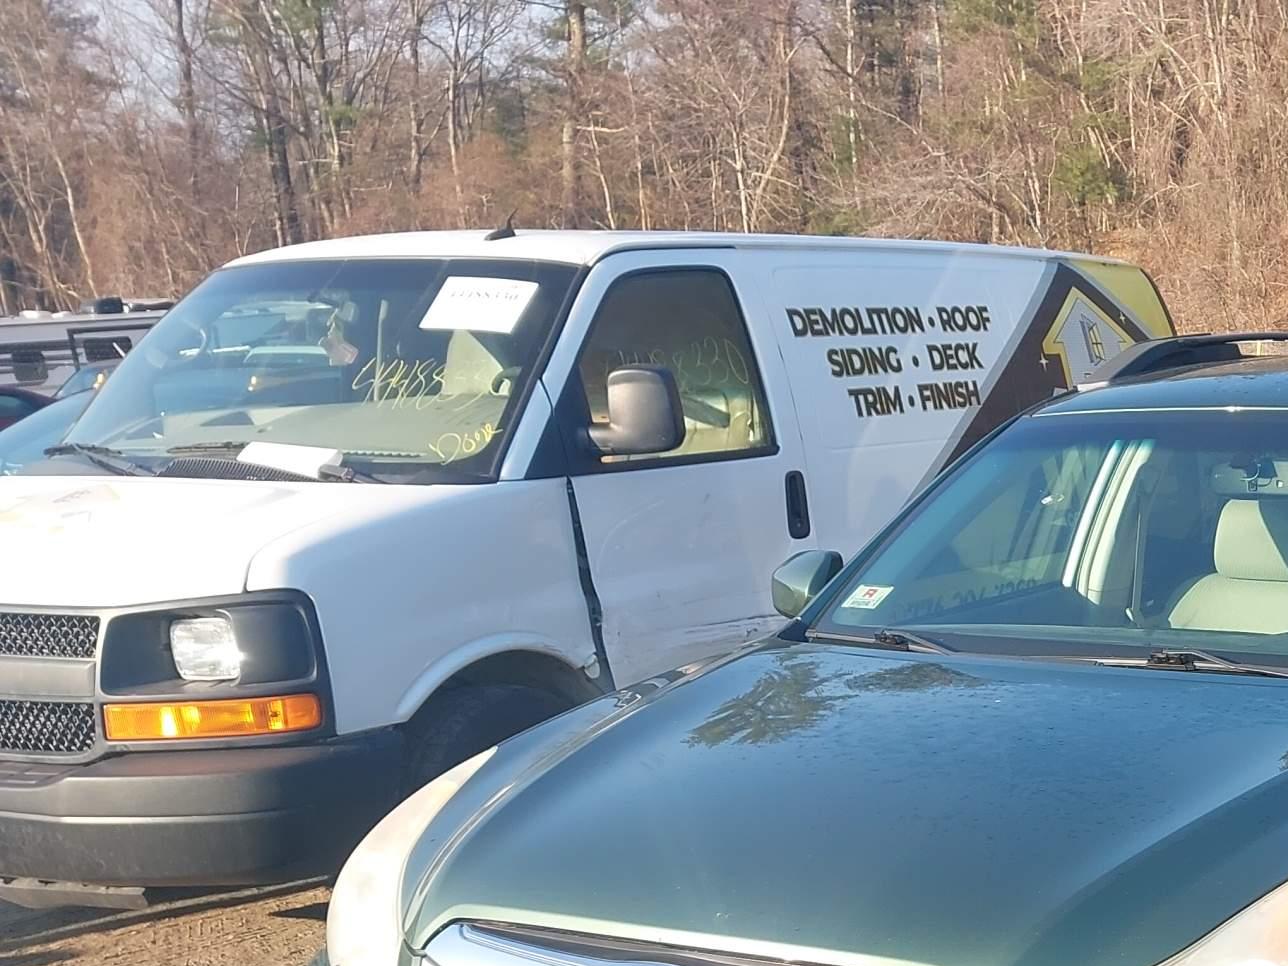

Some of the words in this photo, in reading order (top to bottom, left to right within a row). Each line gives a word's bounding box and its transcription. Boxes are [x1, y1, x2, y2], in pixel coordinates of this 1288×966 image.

[786, 306, 925, 337] DEMOLITION
[936, 305, 991, 332] ROOF
[826, 345, 903, 377] SIDING
[926, 342, 984, 371] DECK
[848, 384, 905, 417] TRIM
[917, 380, 982, 411] FINISH
